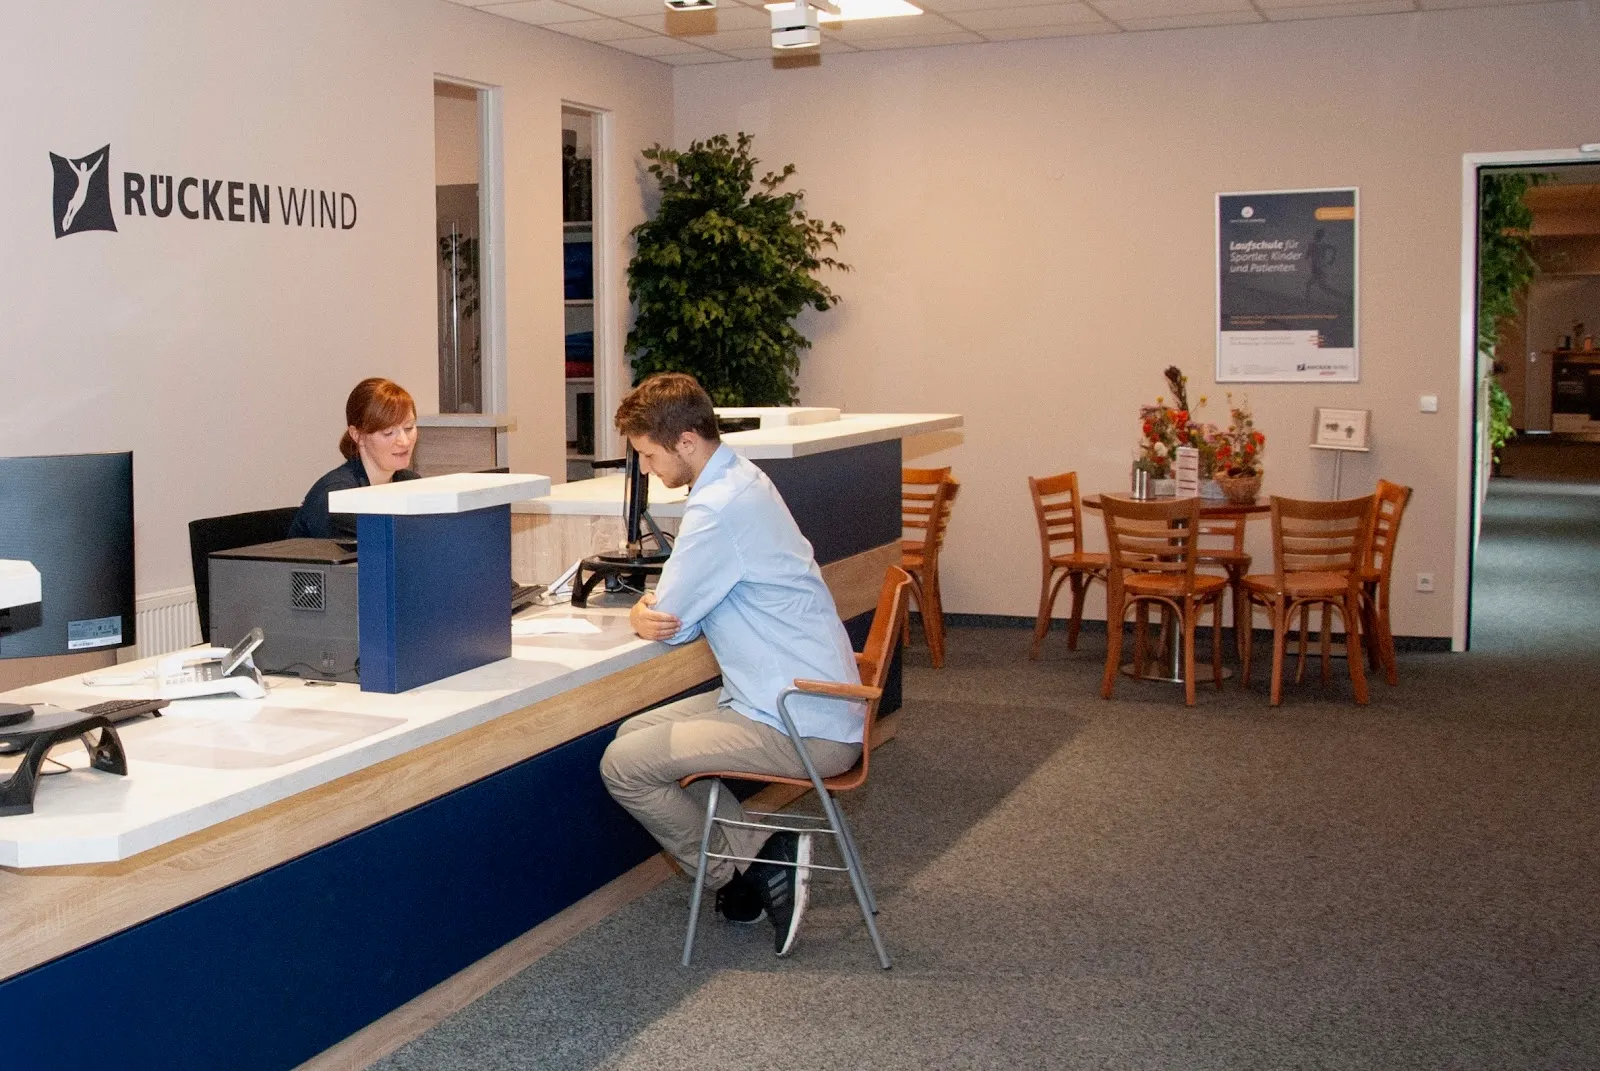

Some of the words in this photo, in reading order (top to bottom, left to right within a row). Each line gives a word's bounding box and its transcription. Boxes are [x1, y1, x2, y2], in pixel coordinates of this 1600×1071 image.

[124, 171, 271, 224] RÜCKEN
[278, 186, 357, 230] WIND
[1229, 240, 1284, 252] Laufschule
[1271, 252, 1302, 260] Kinder
[1229, 264, 1249, 272] und
